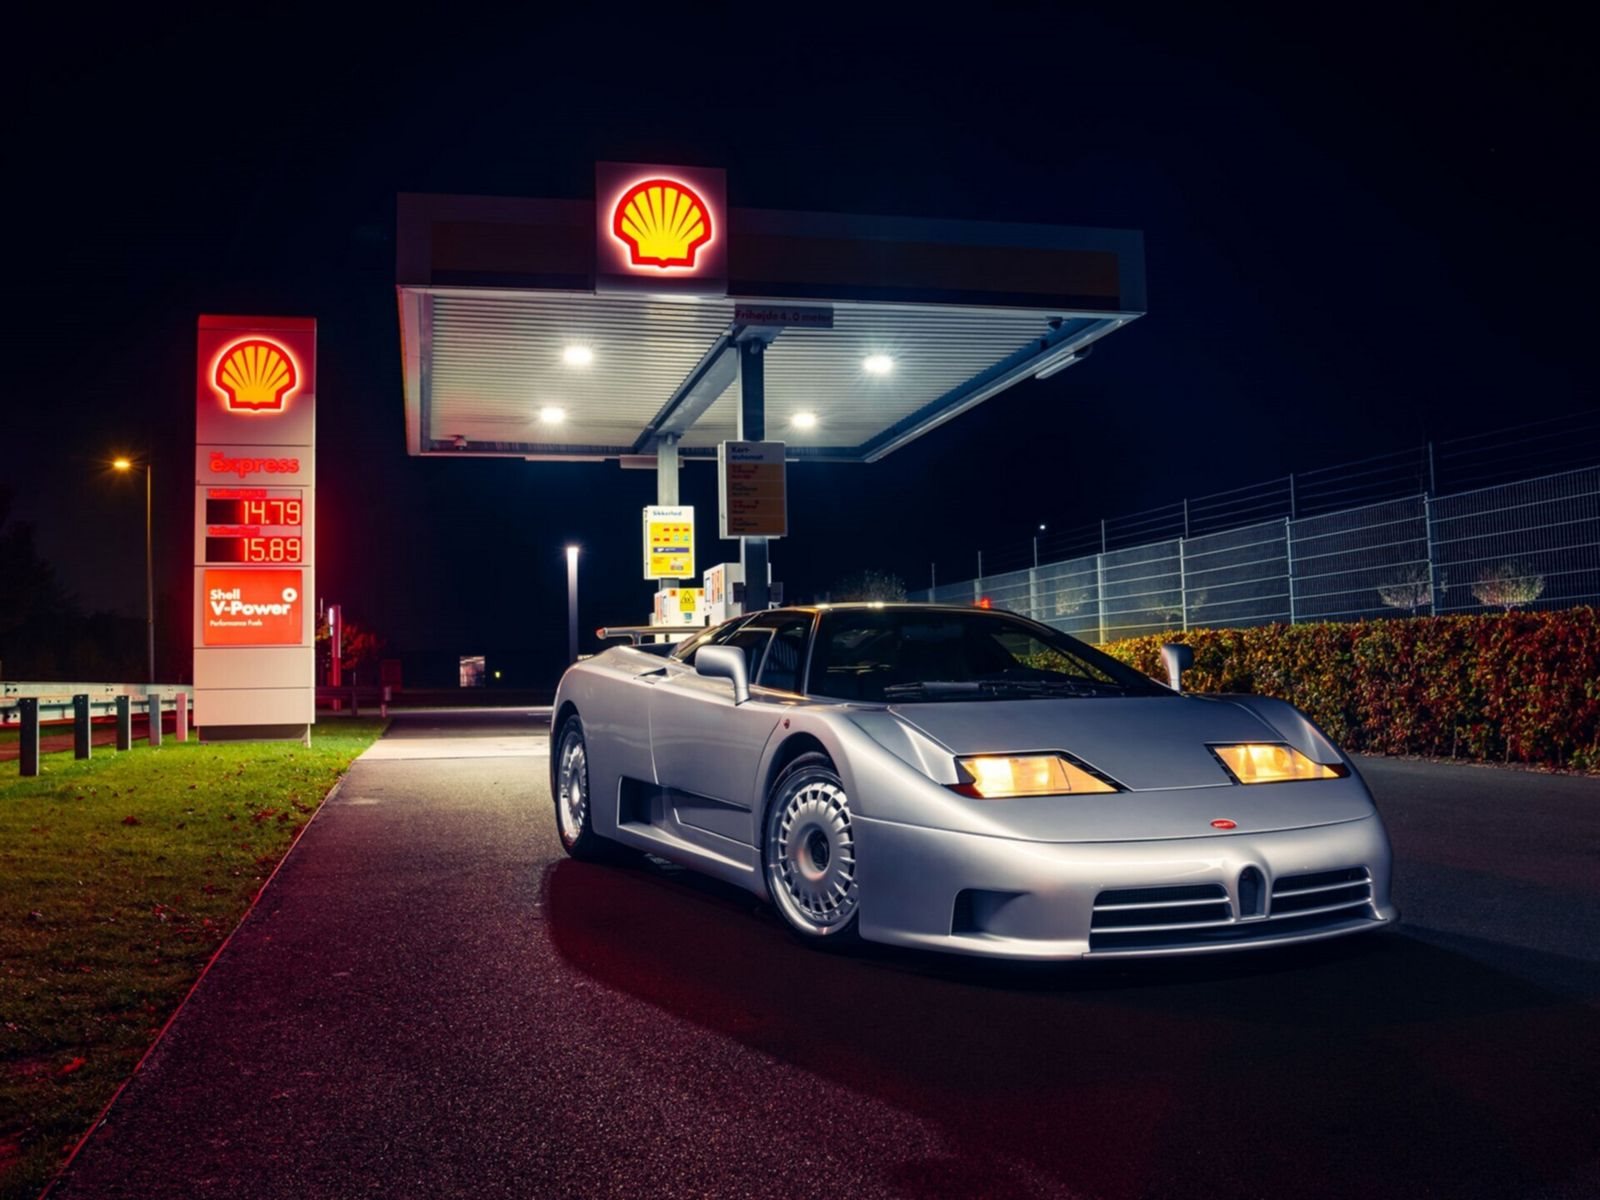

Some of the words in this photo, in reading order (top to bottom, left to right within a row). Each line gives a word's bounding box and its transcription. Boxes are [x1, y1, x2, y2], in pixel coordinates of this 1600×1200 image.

[208, 457, 300, 479] express
[244, 501, 301, 525] 14.79
[244, 538, 301, 562] 15.89
[210, 588, 241, 600] Shell
[210, 601, 291, 616] V-Power
